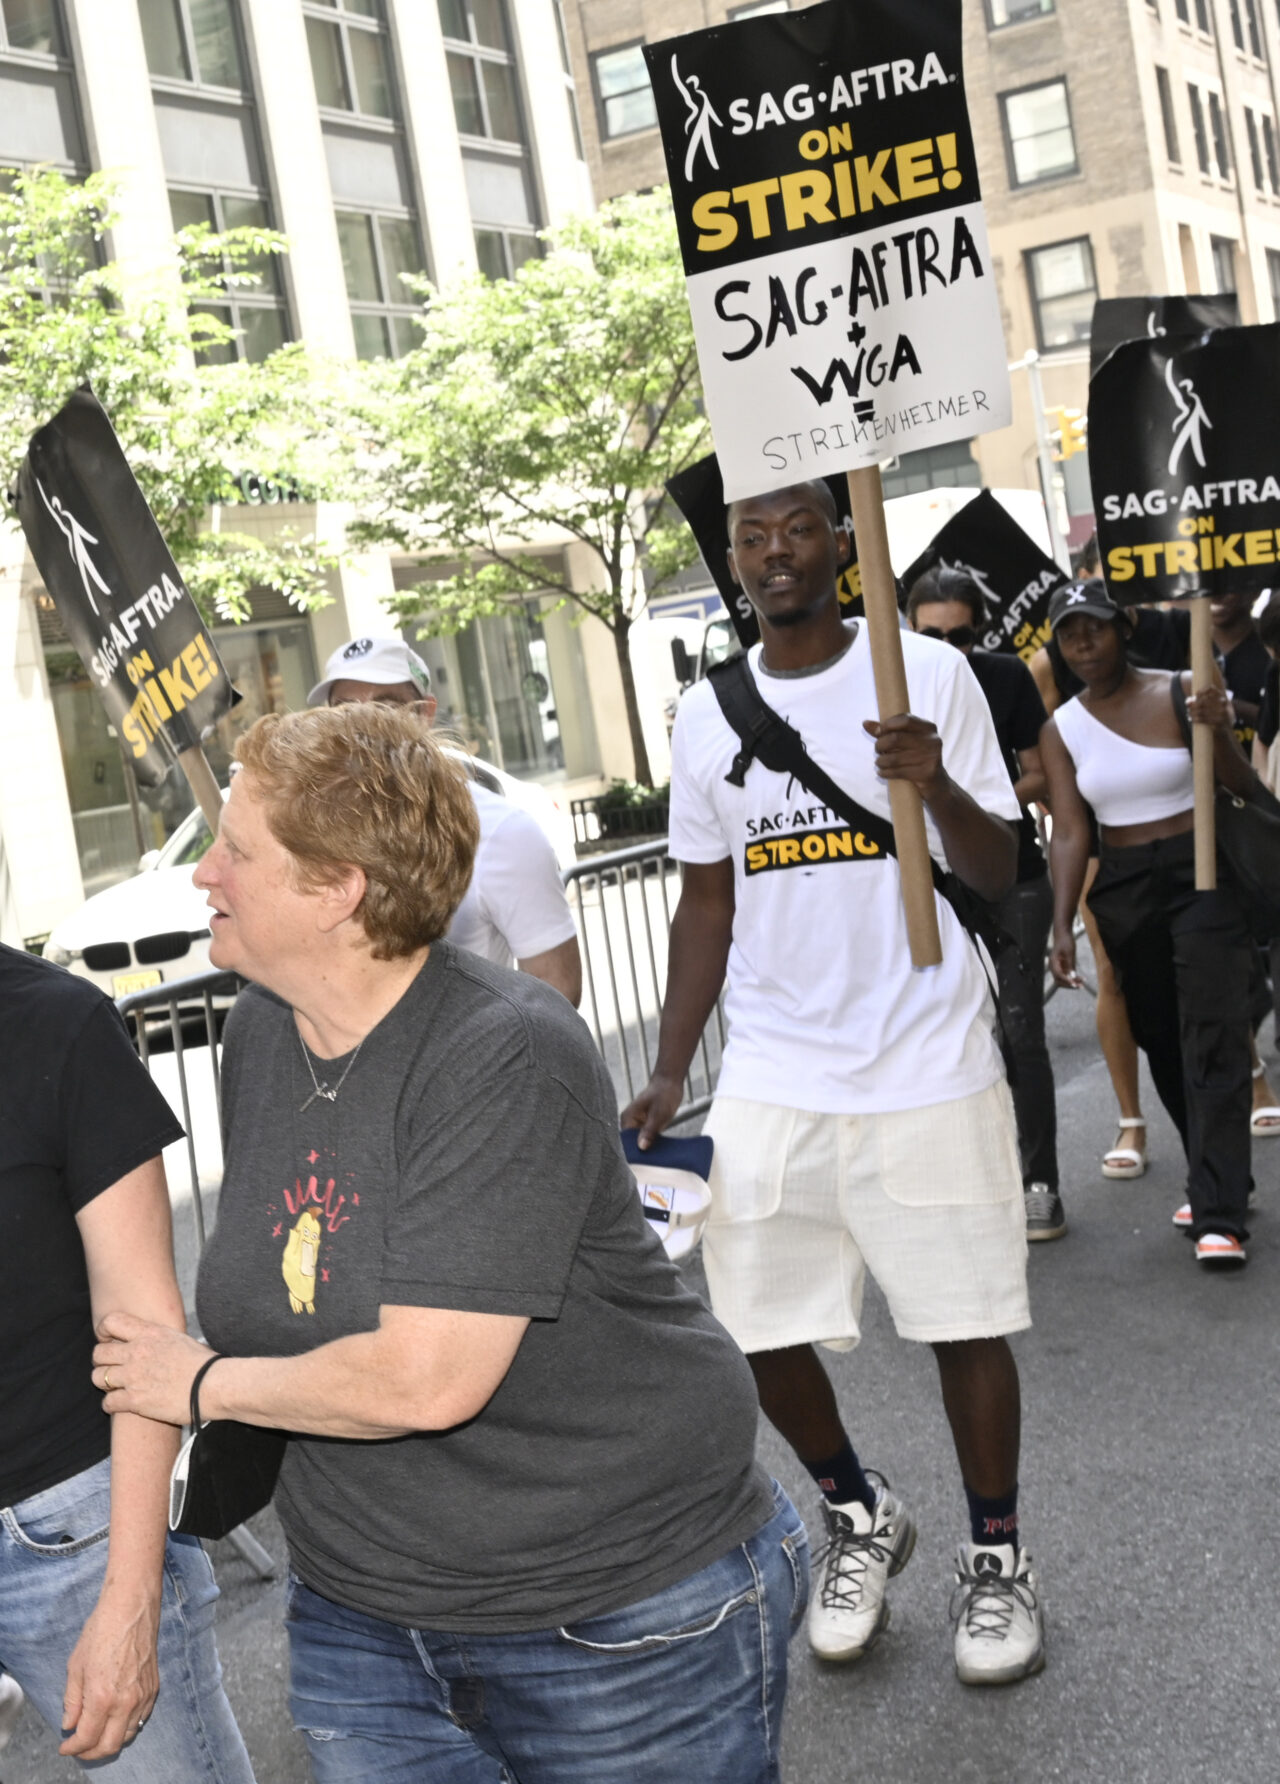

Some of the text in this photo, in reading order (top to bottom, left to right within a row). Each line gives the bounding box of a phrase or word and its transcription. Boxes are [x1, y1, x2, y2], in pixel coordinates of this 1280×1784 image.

[798, 122, 853, 161] ON
[691, 132, 962, 252] STRIKE!
[714, 216, 984, 361] SAG-AFTRA
[790, 334, 922, 406] WGA
[762, 389, 990, 470] STRIKENHEIMER
[1177, 516, 1215, 537] ON
[122, 632, 219, 759] STRIKE!
[125, 648, 155, 685] ON
